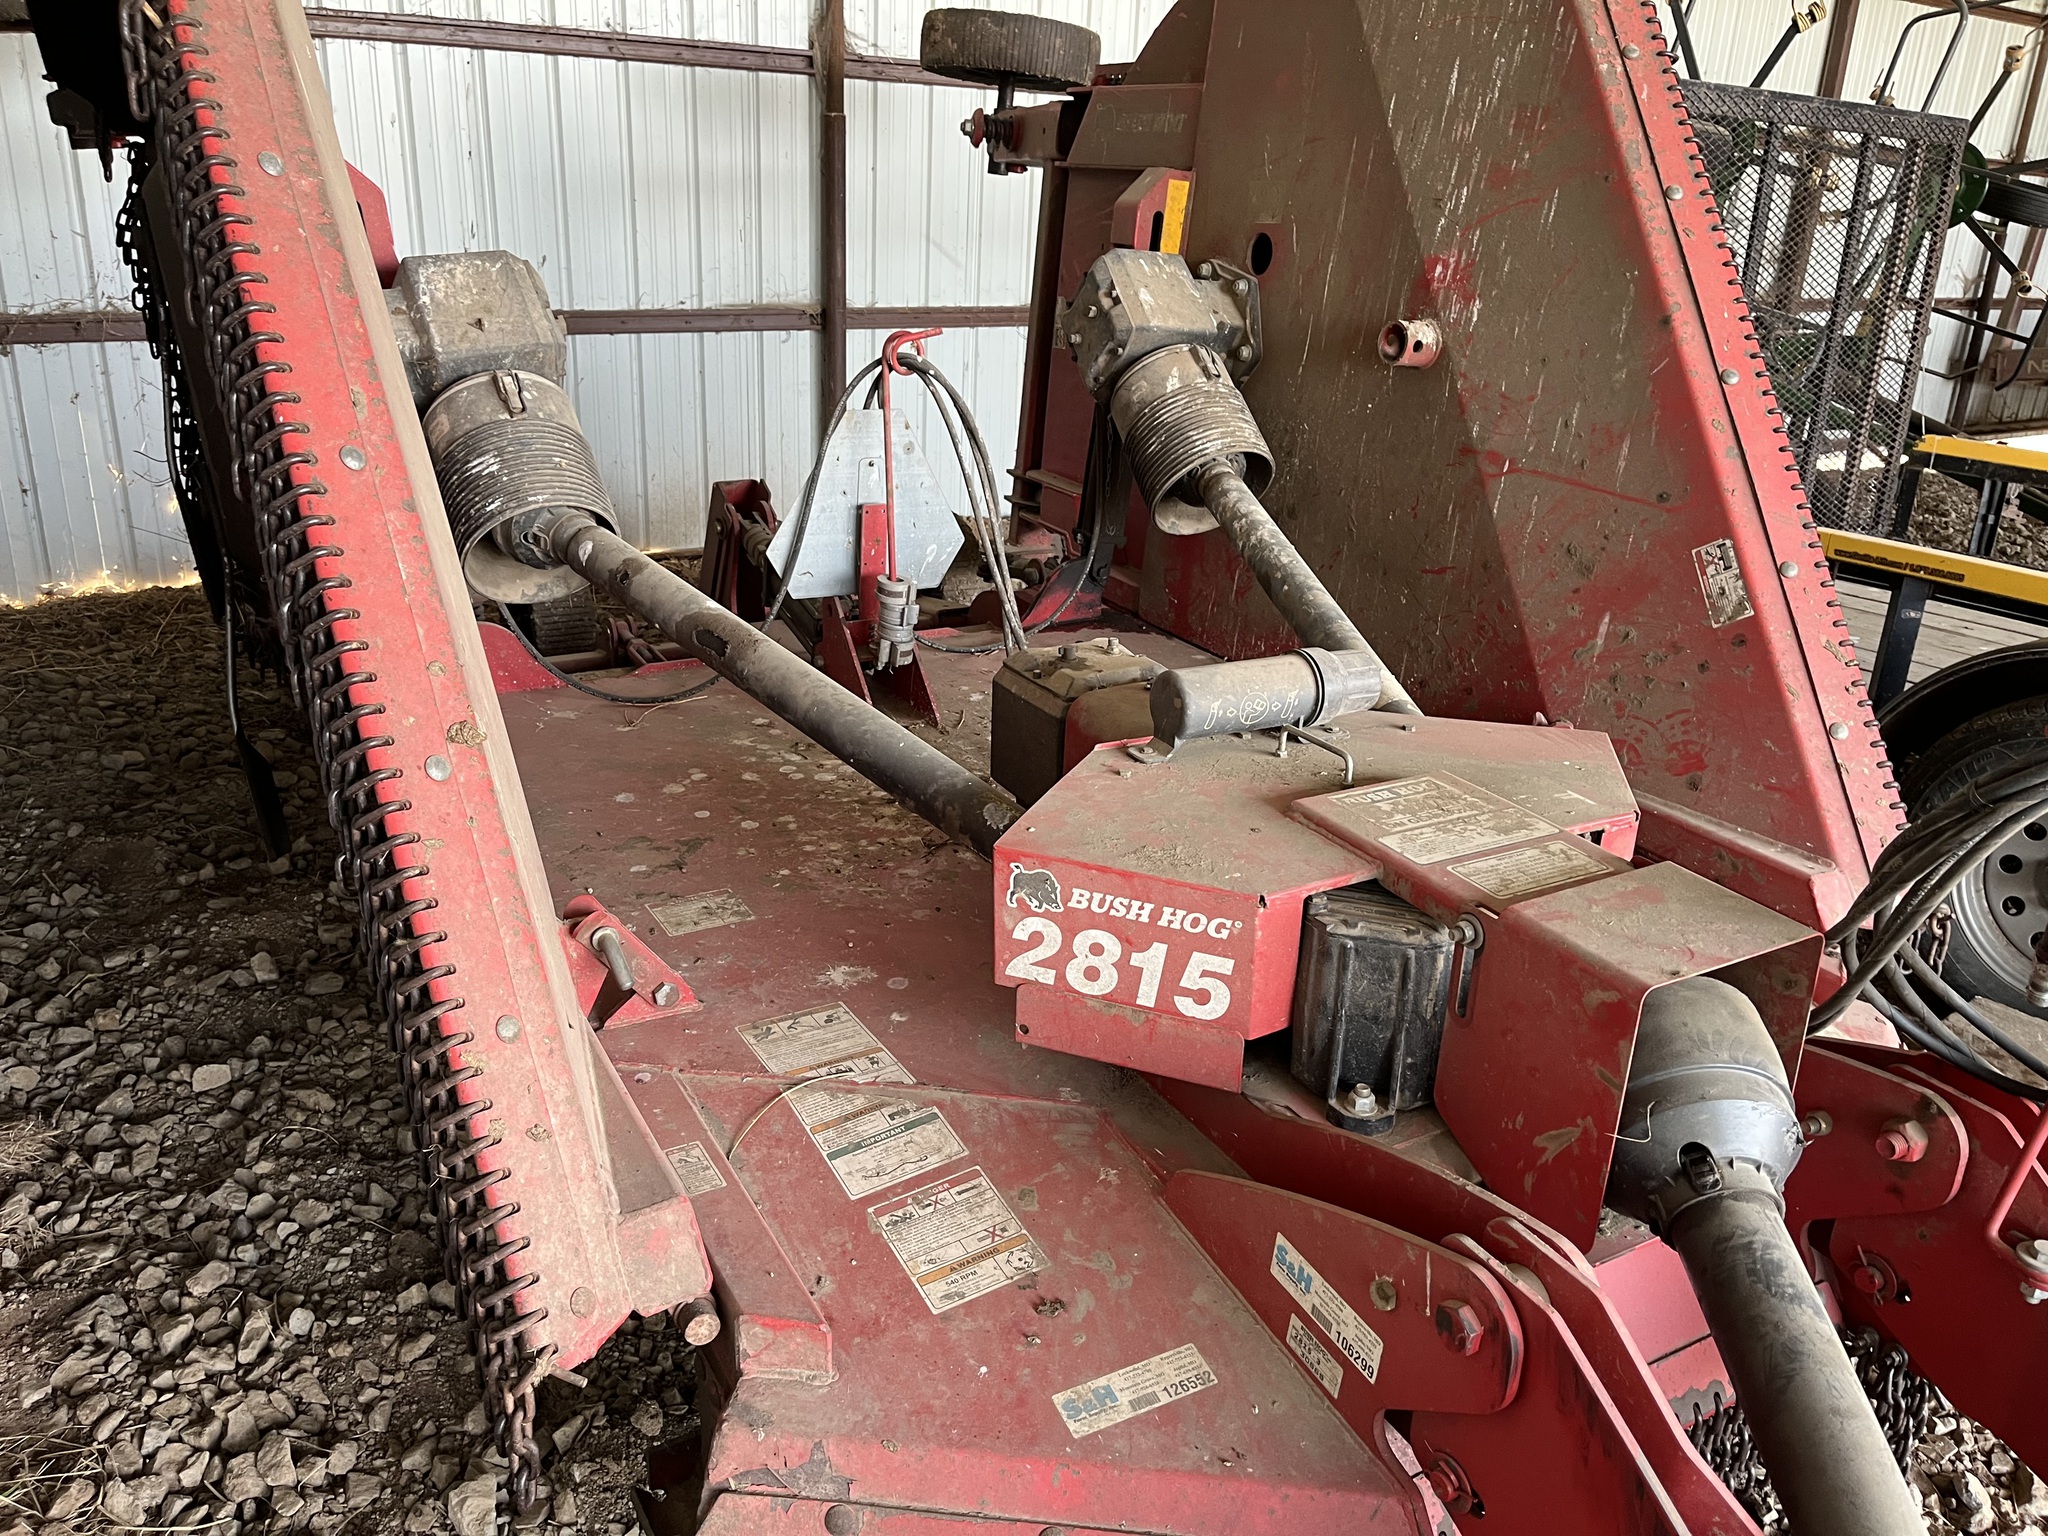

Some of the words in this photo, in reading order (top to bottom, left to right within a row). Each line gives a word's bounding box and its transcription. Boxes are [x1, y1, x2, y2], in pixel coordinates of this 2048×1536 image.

[1067, 887, 1156, 923] BUSH
[1004, 916, 1236, 1021] 2815
[861, 1125, 906, 1147] IMPORTANT
[956, 1246, 1000, 1269] WARNING
[1275, 1243, 1312, 1294] S&H
[944, 1277, 960, 1287] 540
[958, 1269, 978, 1281] RPM
[1335, 1330, 1375, 1380] 106299
[1061, 1383, 1119, 1420] S&H
[1161, 1370, 1216, 1399] 126552
